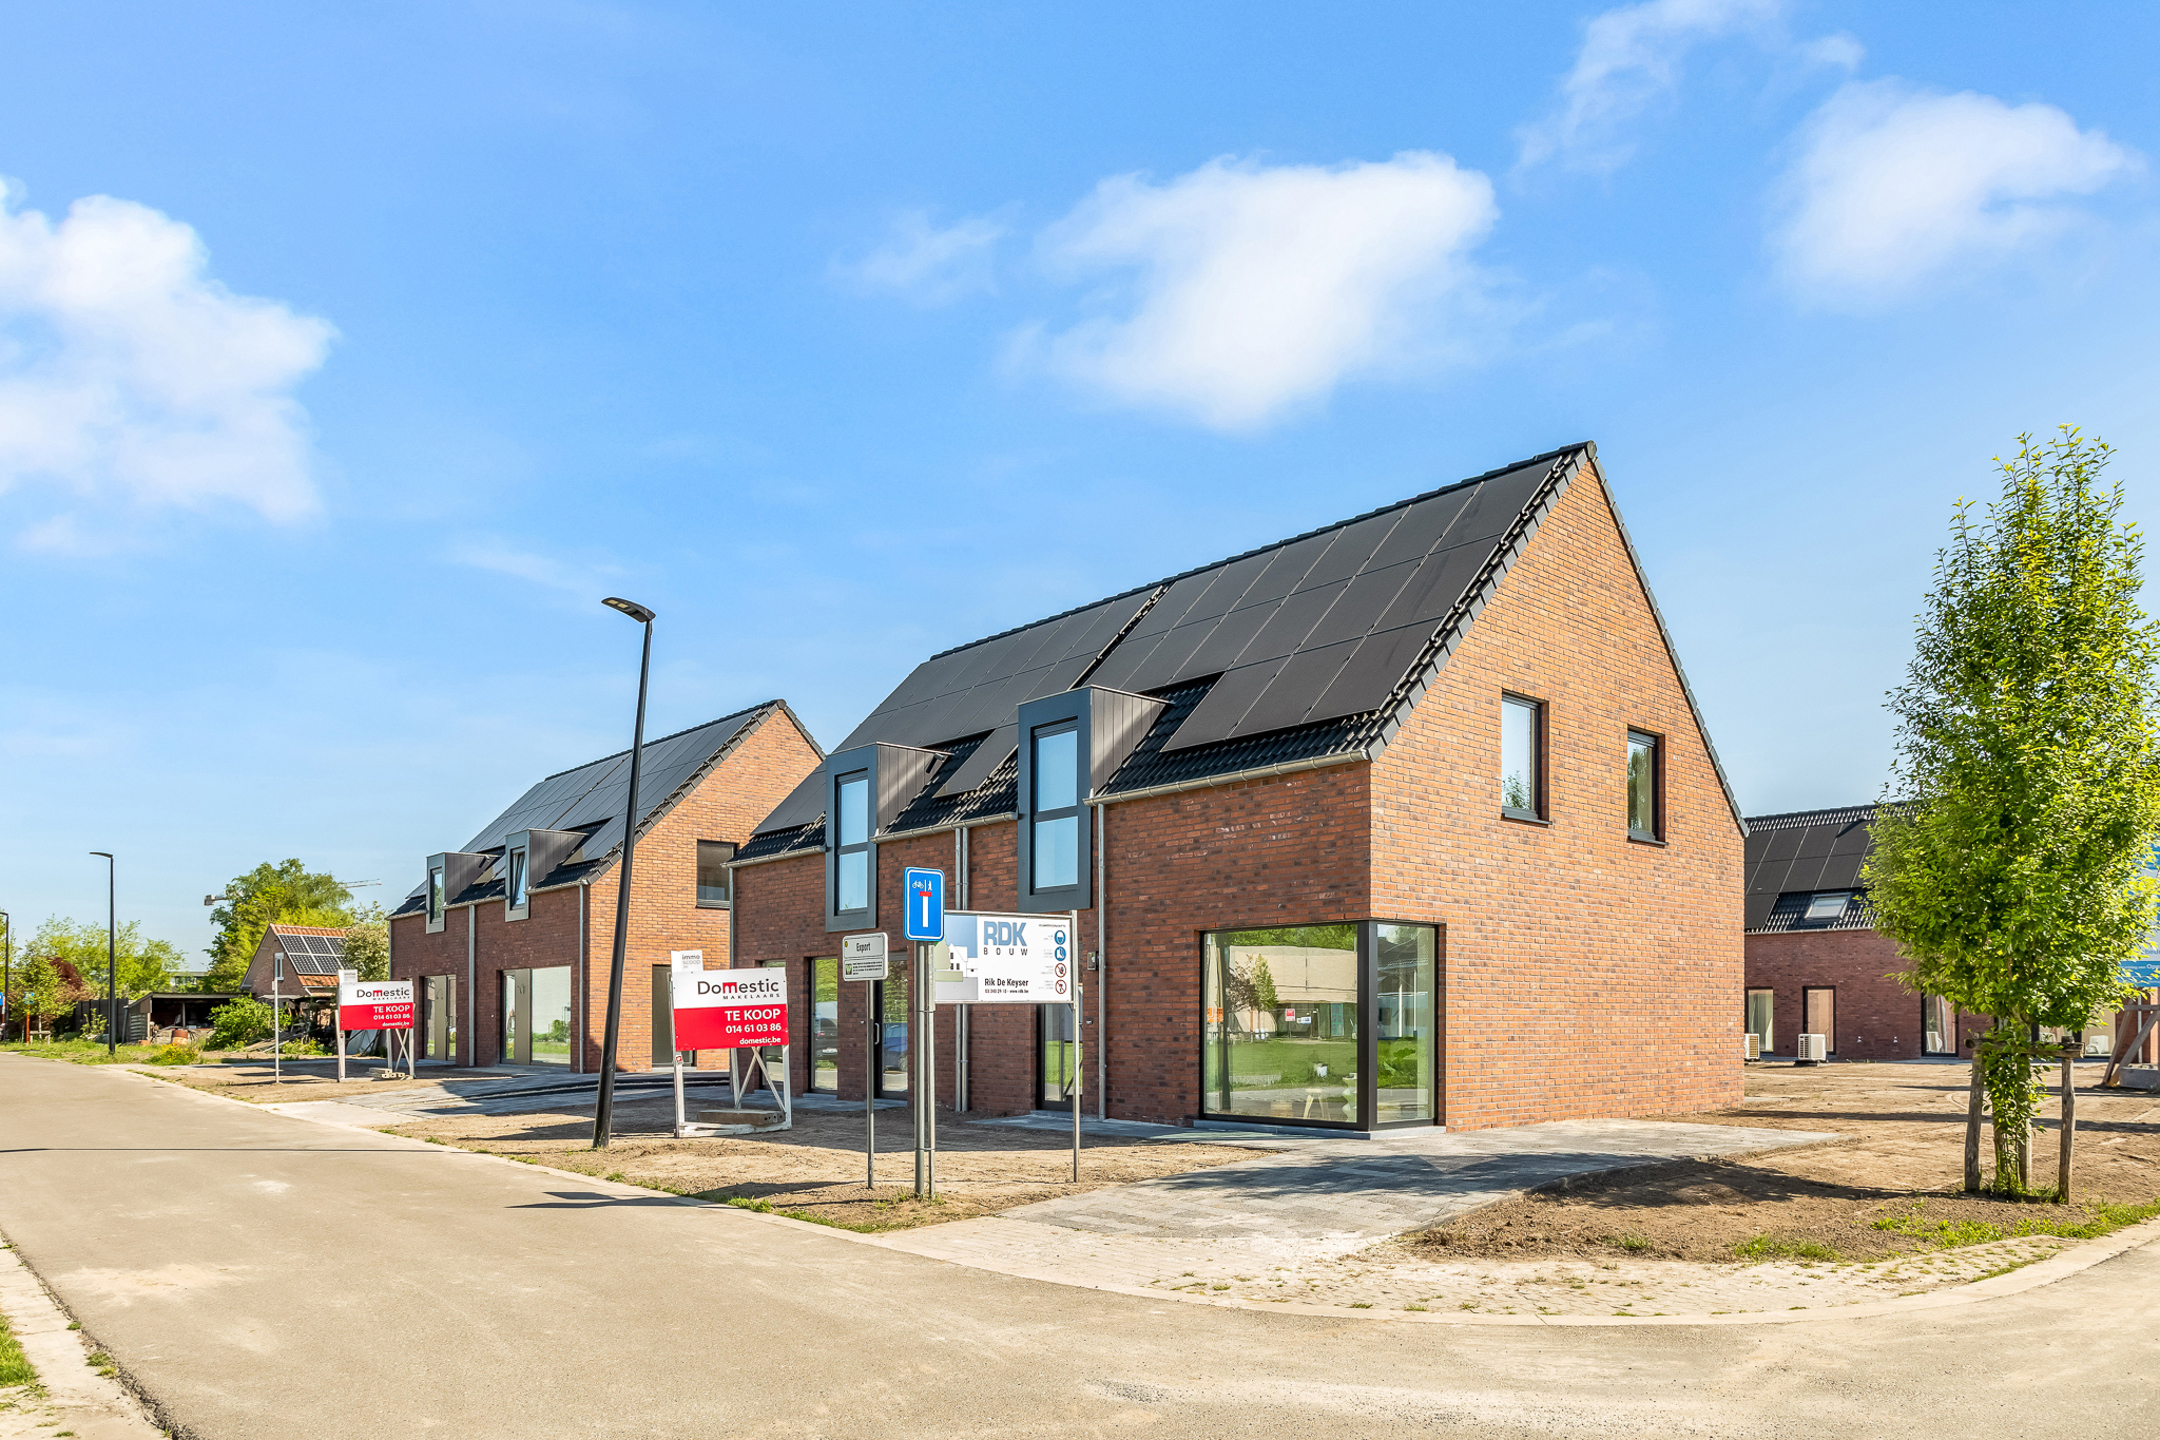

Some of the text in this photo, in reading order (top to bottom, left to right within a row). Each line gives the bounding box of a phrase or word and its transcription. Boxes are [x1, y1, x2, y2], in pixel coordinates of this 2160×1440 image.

[984, 921, 1027, 946] RDK
[856, 942, 871, 953] Export
[984, 947, 1028, 956] BOUW
[697, 978, 779, 995] Domestic
[984, 978, 1029, 988] Rik De Keyser
[356, 987, 410, 998] Domestic
[385, 1004, 411, 1013] KOOP
[724, 1008, 781, 1021] TE KOOP
[725, 1022, 782, 1034] 014 61 03 86
[739, 1036, 781, 1045] domestic.be
